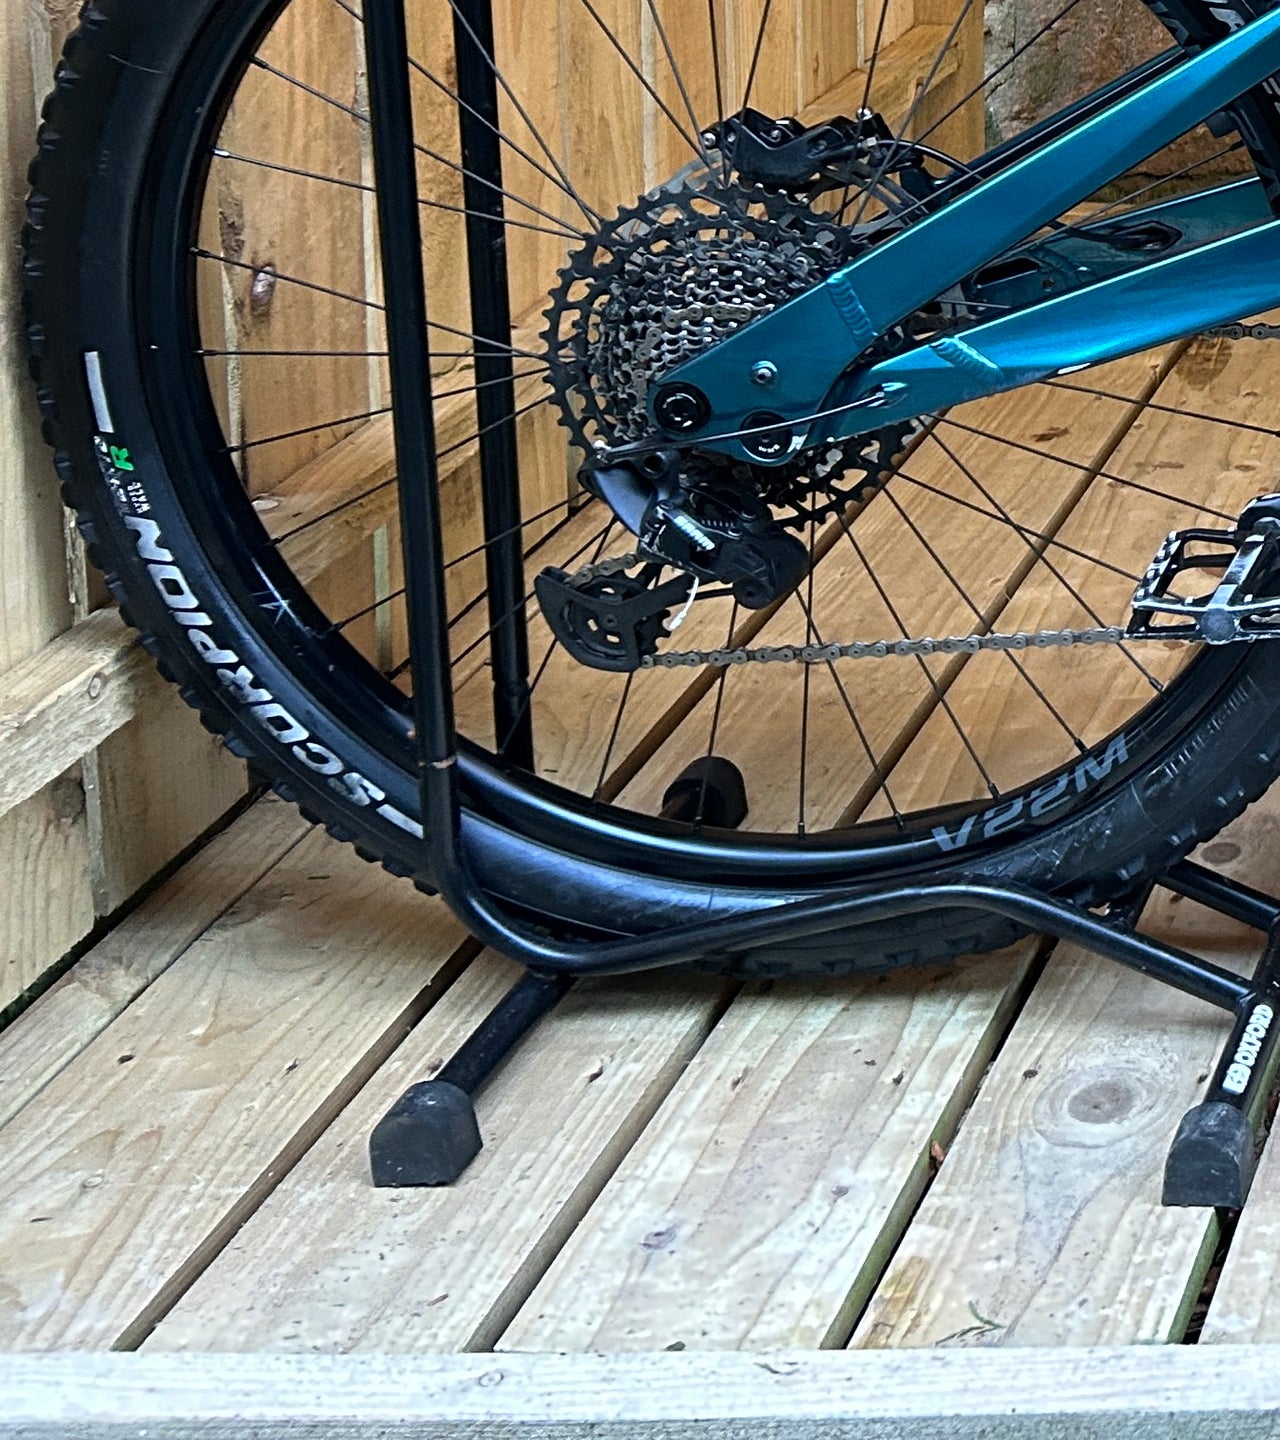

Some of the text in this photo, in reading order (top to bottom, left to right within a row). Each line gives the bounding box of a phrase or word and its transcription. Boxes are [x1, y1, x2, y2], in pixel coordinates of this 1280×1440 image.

[124, 514, 387, 807] SCORPION
[930, 732, 1131, 852] V22M
[1234, 1004, 1274, 1068] OXFORD
